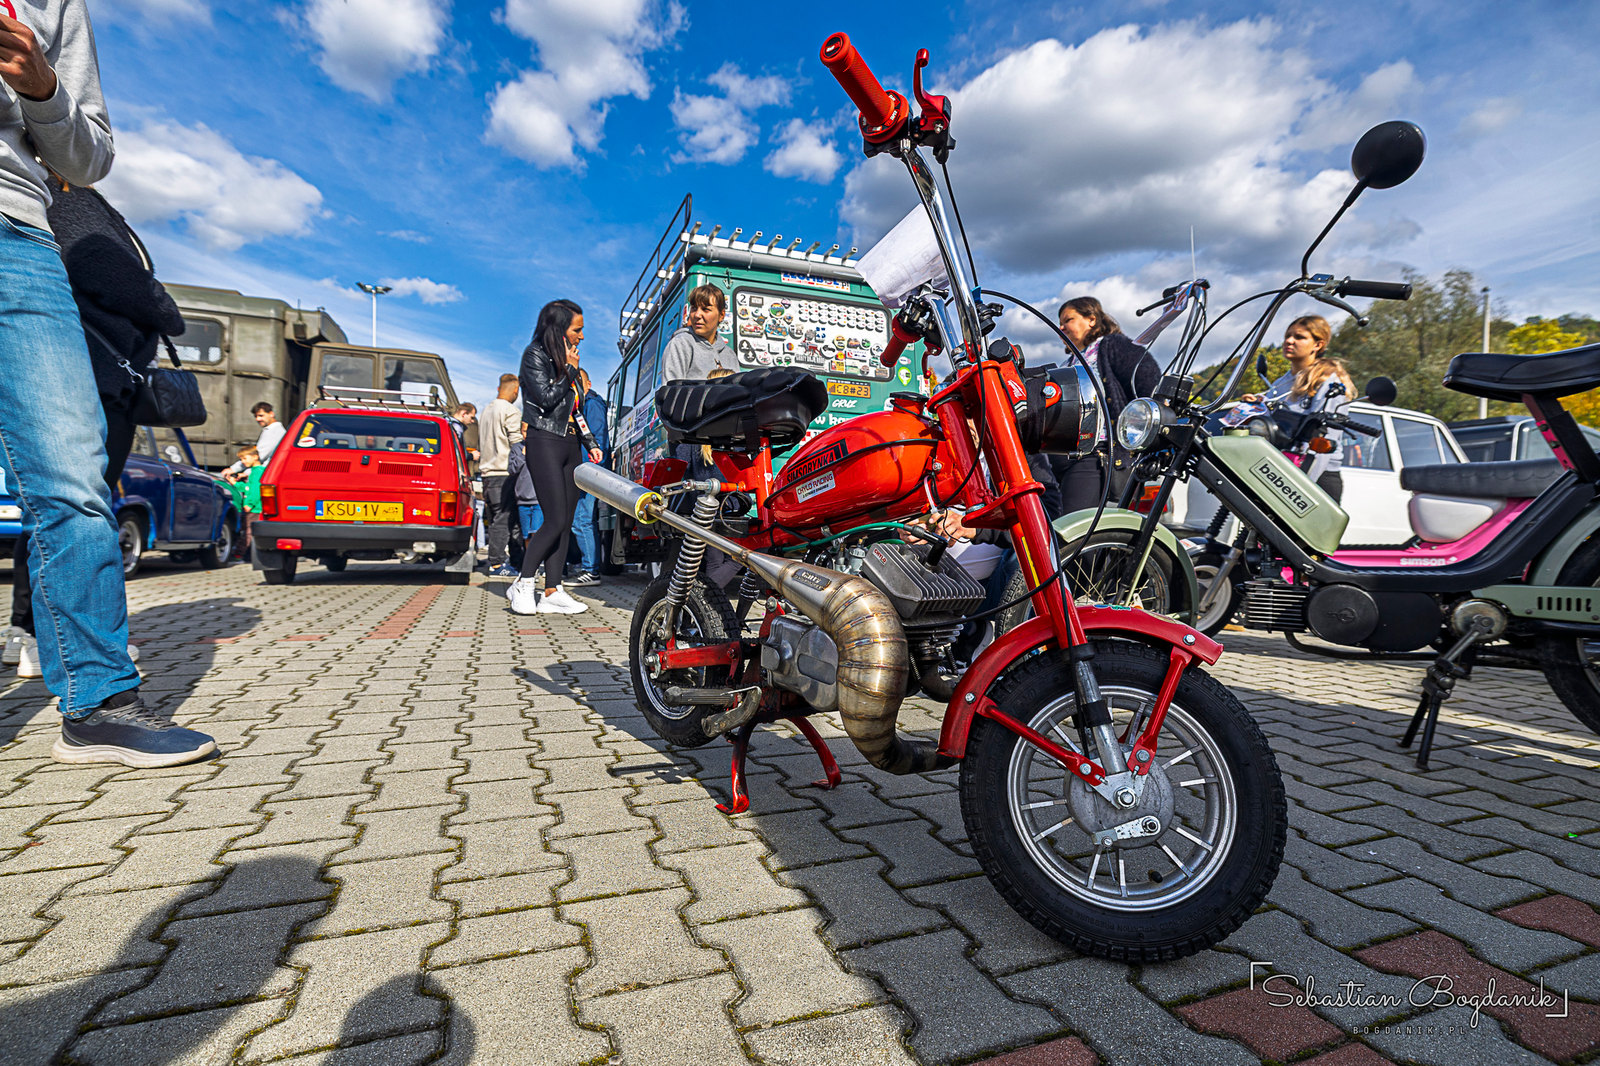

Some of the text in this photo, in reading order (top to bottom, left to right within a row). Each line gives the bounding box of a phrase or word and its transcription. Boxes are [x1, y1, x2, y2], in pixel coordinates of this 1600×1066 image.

[831, 399, 858, 408] GRUZ
[1258, 463, 1309, 511] babetta
[326, 502, 379, 516] KSU 1V
[1400, 558, 1446, 566] simson
